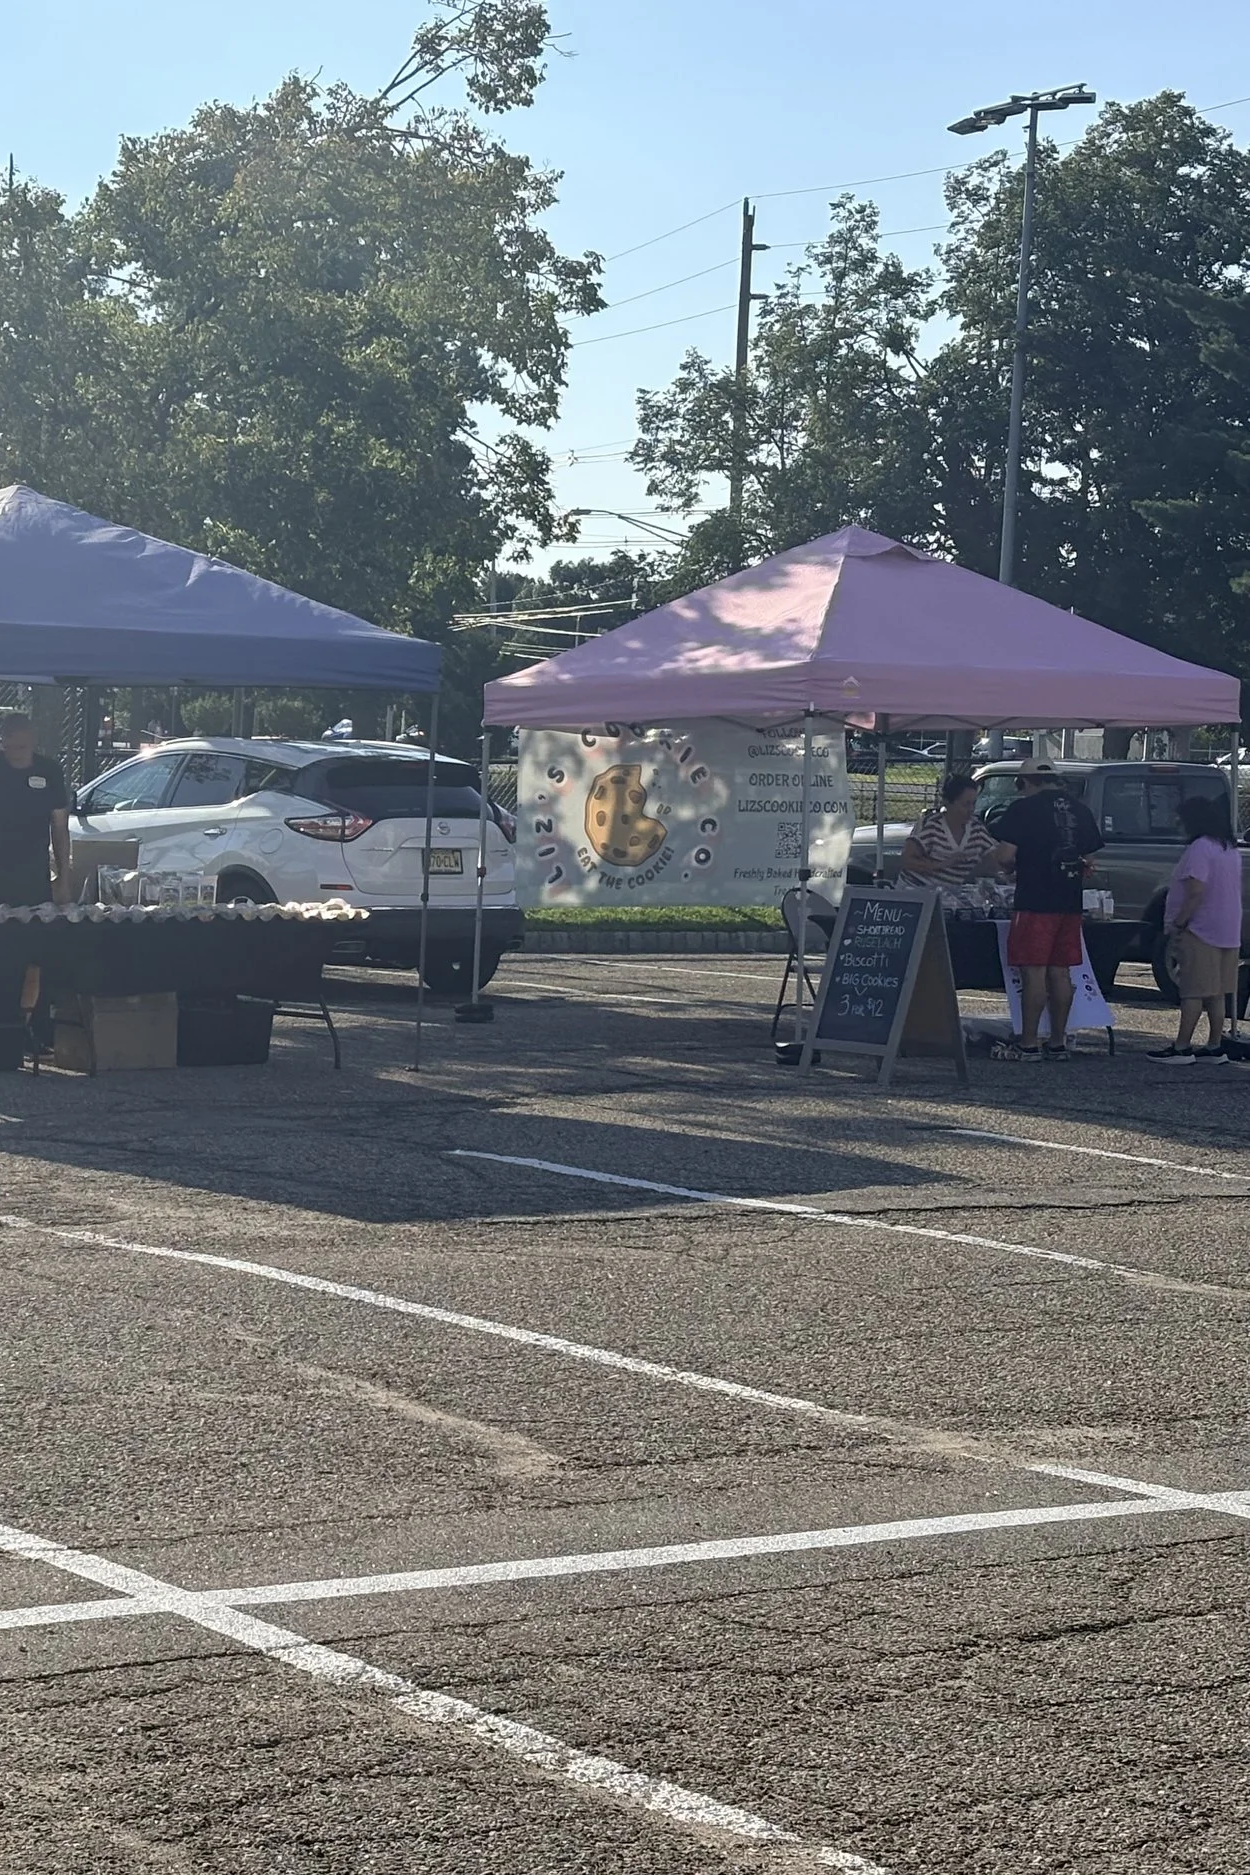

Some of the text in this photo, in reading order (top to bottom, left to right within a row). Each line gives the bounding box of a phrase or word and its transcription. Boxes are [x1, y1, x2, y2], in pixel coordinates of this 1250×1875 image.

[748, 745, 829, 758] @LIZSCOOECO
[749, 773, 789, 787] ORDER
[431, 855, 441, 867] 70
[577, 846, 674, 890] EAT THE COOKIE!
[734, 867, 842, 881] Freshly Baked Hdcrafted
[863, 901, 903, 922] MENU
[842, 973, 860, 985] BIG
[838, 994, 883, 1017] 3 FOR $12
